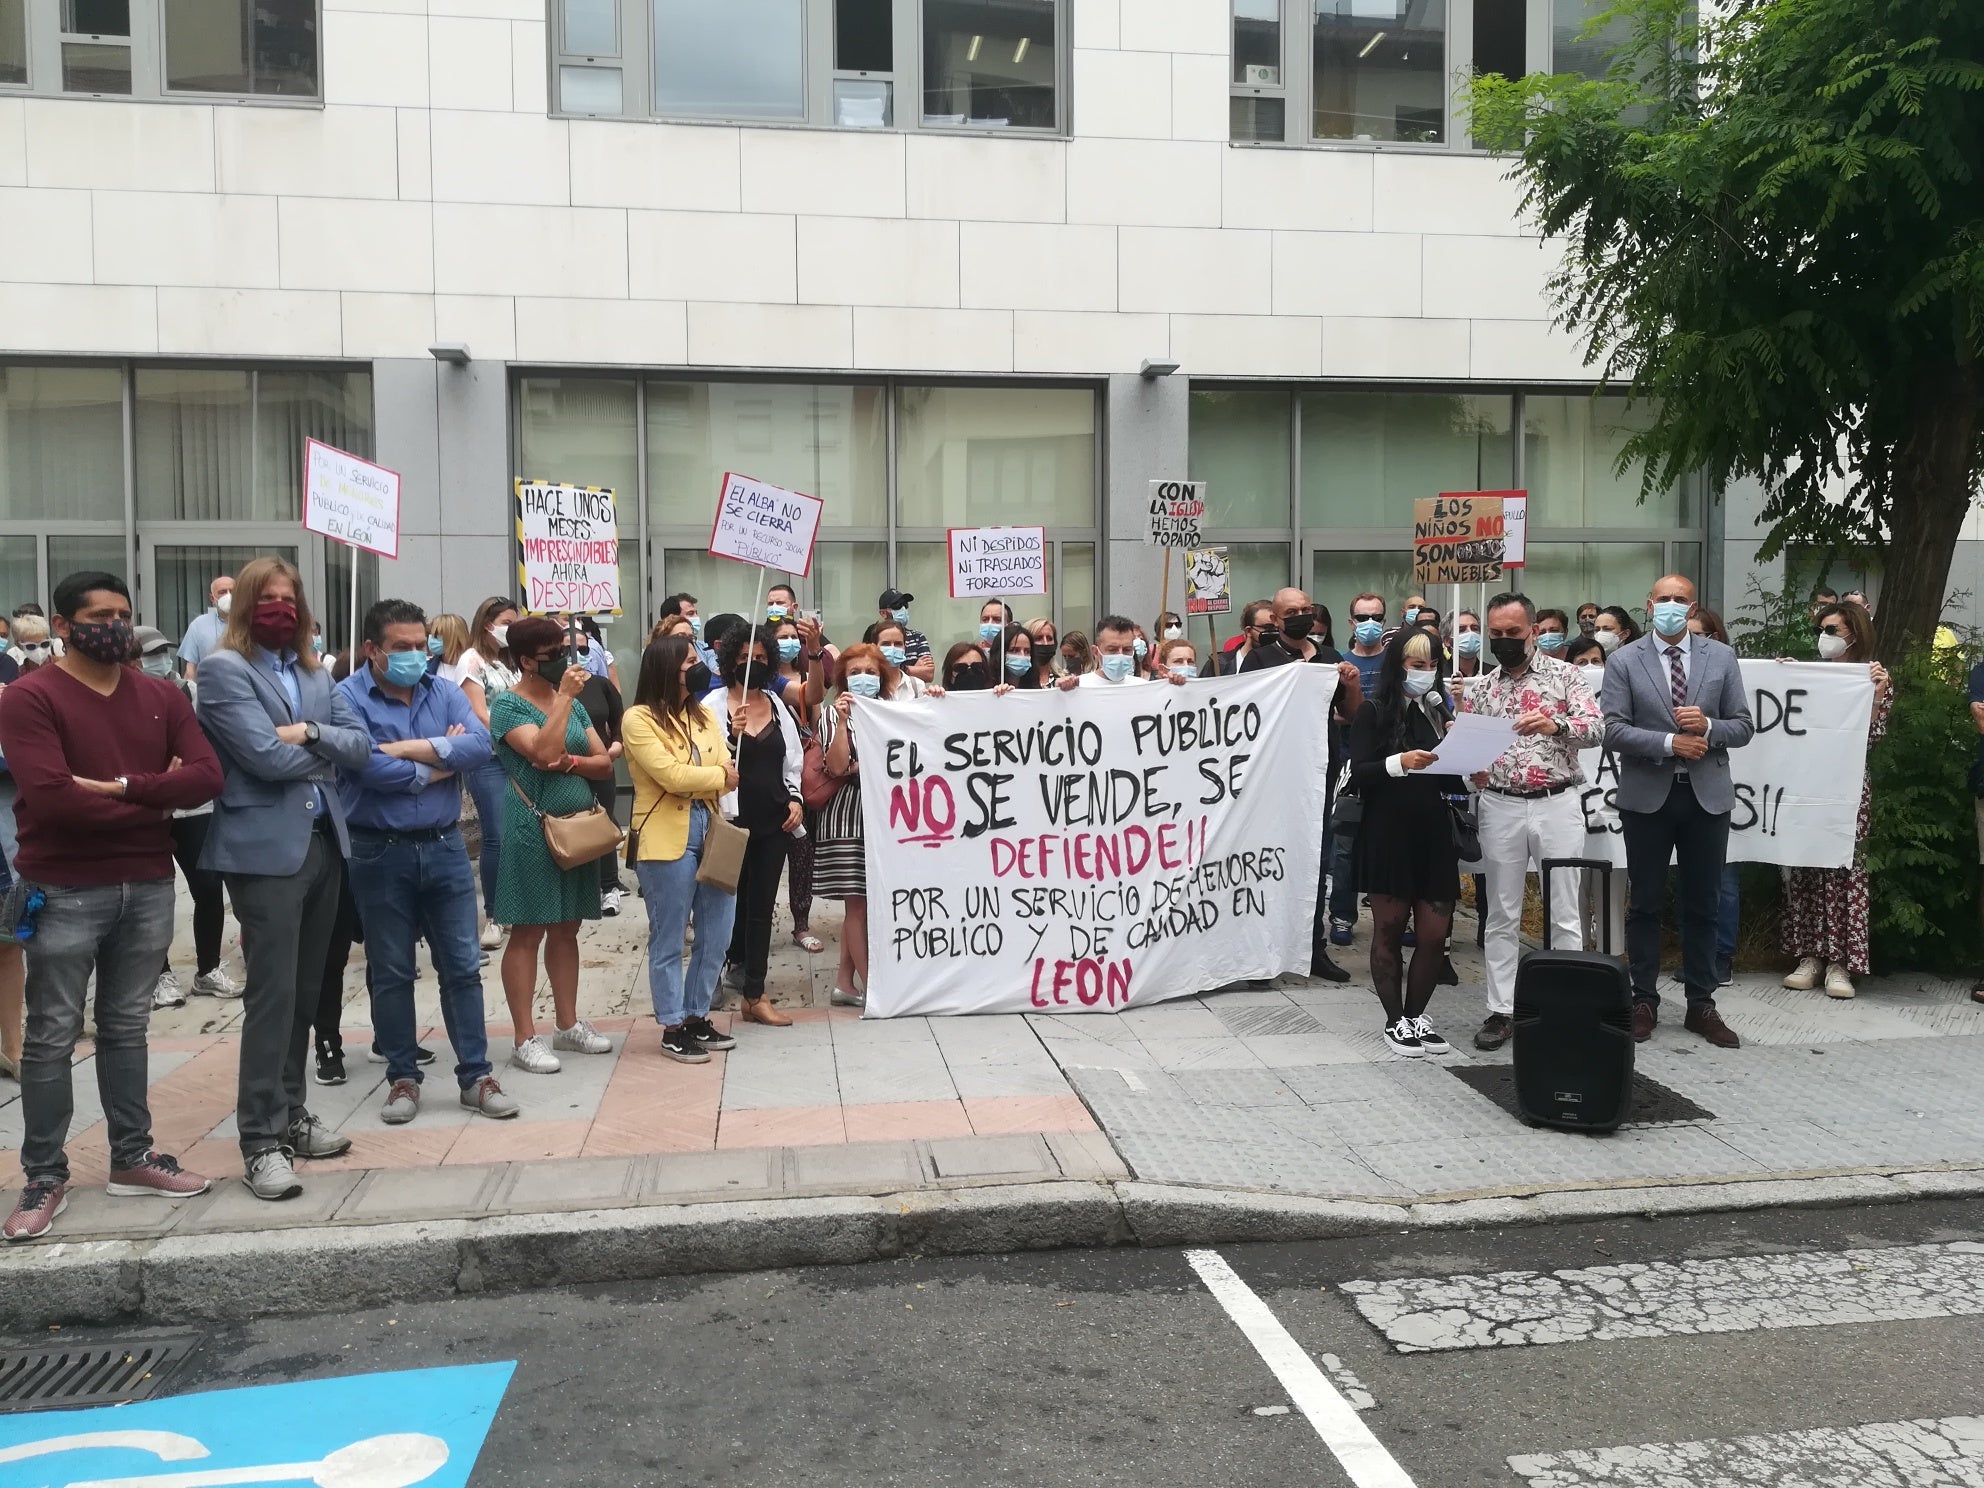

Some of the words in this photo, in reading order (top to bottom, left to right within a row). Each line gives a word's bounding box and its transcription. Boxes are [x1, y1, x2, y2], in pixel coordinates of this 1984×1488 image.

[350, 469, 389, 495] SERVICIO
[1158, 482, 1196, 501] CON
[525, 488, 564, 516] HACE
[573, 492, 612, 522] UNOS
[782, 503, 802, 521] NO
[1150, 500, 1167, 515] LA
[1434, 499, 1473, 519] LOS
[367, 515, 396, 533] CALIDAD
[725, 503, 743, 518] SE
[747, 511, 793, 534] CIERRA
[1151, 517, 1198, 532] HEMOS
[1415, 518, 1472, 538] NIÑOS
[1475, 515, 1504, 537] NO
[328, 519, 343, 534] EN
[346, 521, 373, 544] LEÓN
[720, 520, 735, 532] POR
[739, 526, 748, 536] UN
[753, 529, 783, 547] RECURSO
[1152, 532, 1201, 548] TOPADO
[981, 537, 1040, 554] DESPIDOS
[1416, 543, 1455, 565] SON
[551, 564, 588, 583] AHORA
[976, 556, 1042, 573] TRASLADOS
[1417, 562, 1430, 582] NI
[1438, 562, 1503, 581] MUEBLES
[532, 577, 615, 610] DESPIDOS
[966, 576, 1034, 590] FORZOSOS
[1187, 597, 1207, 613] NO
[1755, 689, 1808, 736] DE
[886, 739, 924, 779] EL
[944, 717, 1102, 771] SERVICIO
[1131, 697, 1261, 756] PÚBLICO
[890, 775, 956, 835] NO
[960, 772, 1017, 838] SE
[1040, 765, 1182, 826] VENDE,
[1199, 754, 1251, 805] SE
[990, 815, 1207, 882] DEFIENDE!!
[892, 887, 949, 921] POR
[966, 886, 1000, 919] UN
[1011, 881, 1140, 921] SERVICIO
[1151, 875, 1185, 915] DE
[1187, 847, 1285, 898] MENORES
[893, 917, 1003, 962] PÚBLICO
[1025, 923, 1048, 965] Y
[1070, 925, 1114, 961] DE
[1232, 888, 1265, 917] EN
[1031, 956, 1133, 1007] LEÓN
